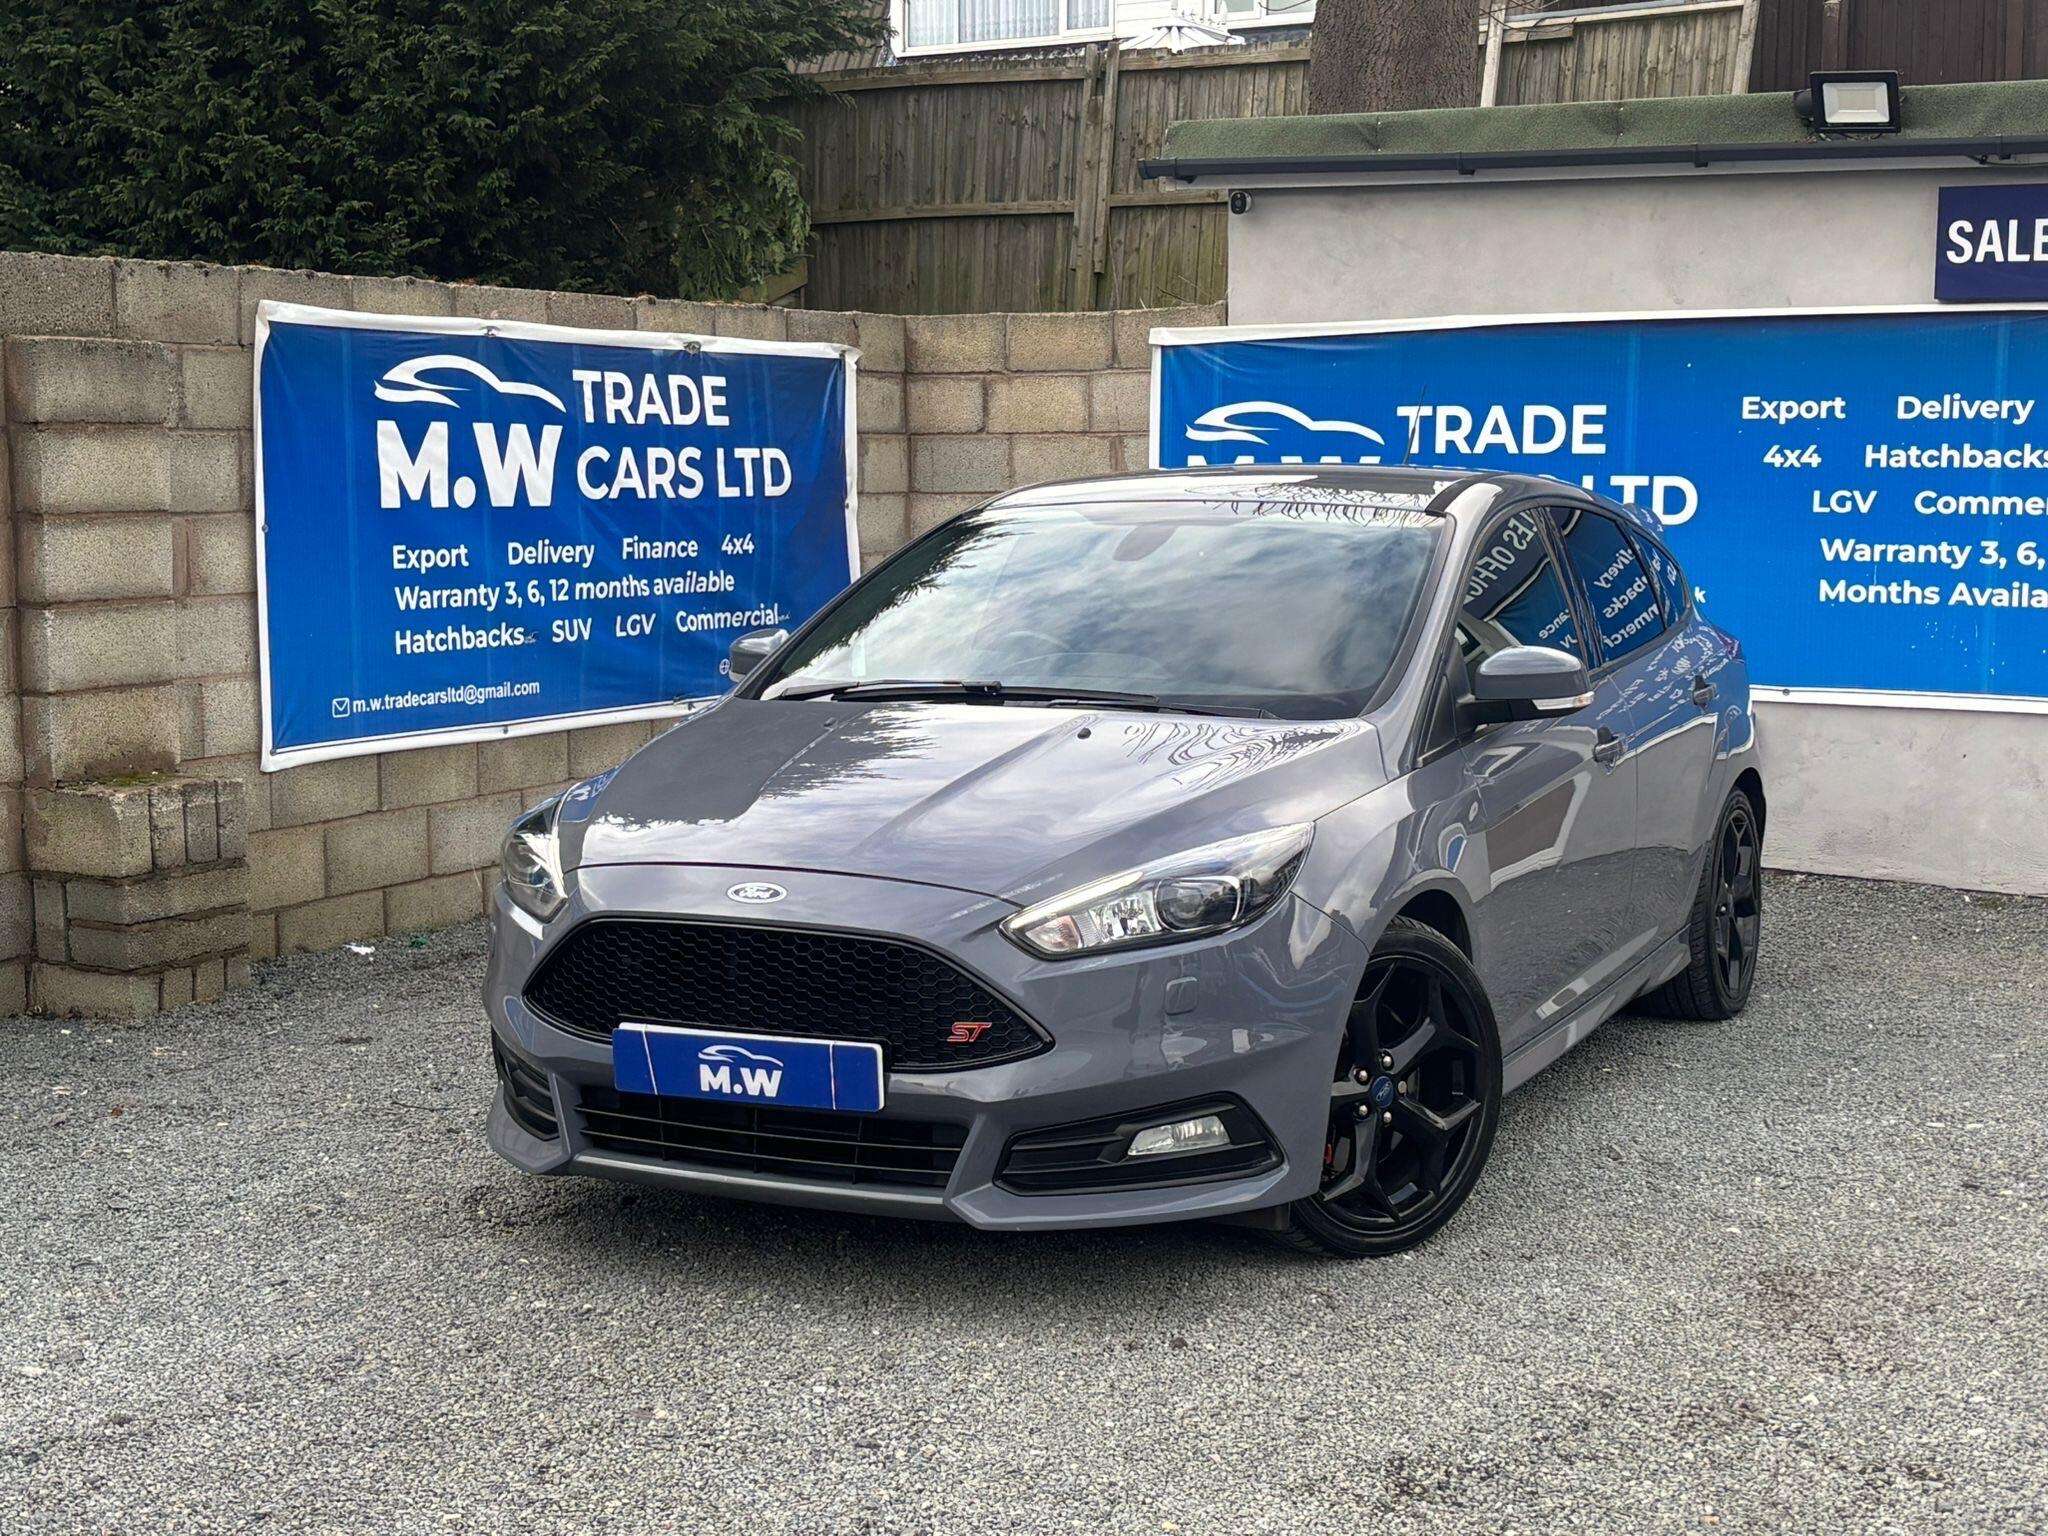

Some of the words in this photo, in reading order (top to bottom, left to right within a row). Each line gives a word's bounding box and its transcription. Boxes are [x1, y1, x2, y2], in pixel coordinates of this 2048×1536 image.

[573, 370, 729, 426] TRADE
[1741, 396, 1846, 424] Export
[1896, 393, 2034, 425] Delivery
[1396, 405, 1607, 454] TRADE
[377, 420, 562, 508] M.W
[577, 447, 701, 500] CARS
[717, 448, 792, 498] LTD
[1763, 445, 1822, 468] 4x4
[1582, 475, 1698, 525] TD
[1812, 491, 1877, 514] LGV
[1914, 490, 2048, 516] Comme
[392, 544, 469, 574] Export
[507, 539, 595, 568] Delivery
[622, 535, 699, 560] Finance
[721, 533, 755, 555] 4x4
[1820, 538, 1972, 570] Warranty
[1979, 541, 2007, 570] 3,
[2016, 541, 2046, 571] 6,
[395, 584, 500, 612] Warranty
[504, 581, 523, 608] 3,
[527, 580, 546, 607] 6,
[549, 579, 569, 601] 12
[575, 574, 650, 600] months
[653, 570, 735, 596] available
[1818, 580, 1941, 605] Months
[395, 622, 525, 655] Hatchbacks
[552, 617, 592, 643] SUV
[615, 613, 656, 637] LGV
[675, 603, 779, 632] Commercial
[353, 681, 540, 713] m.w.tradecarsltd@gmail.com
[947, 1021, 992, 1042] ST
[700, 1064, 782, 1097] M.W
